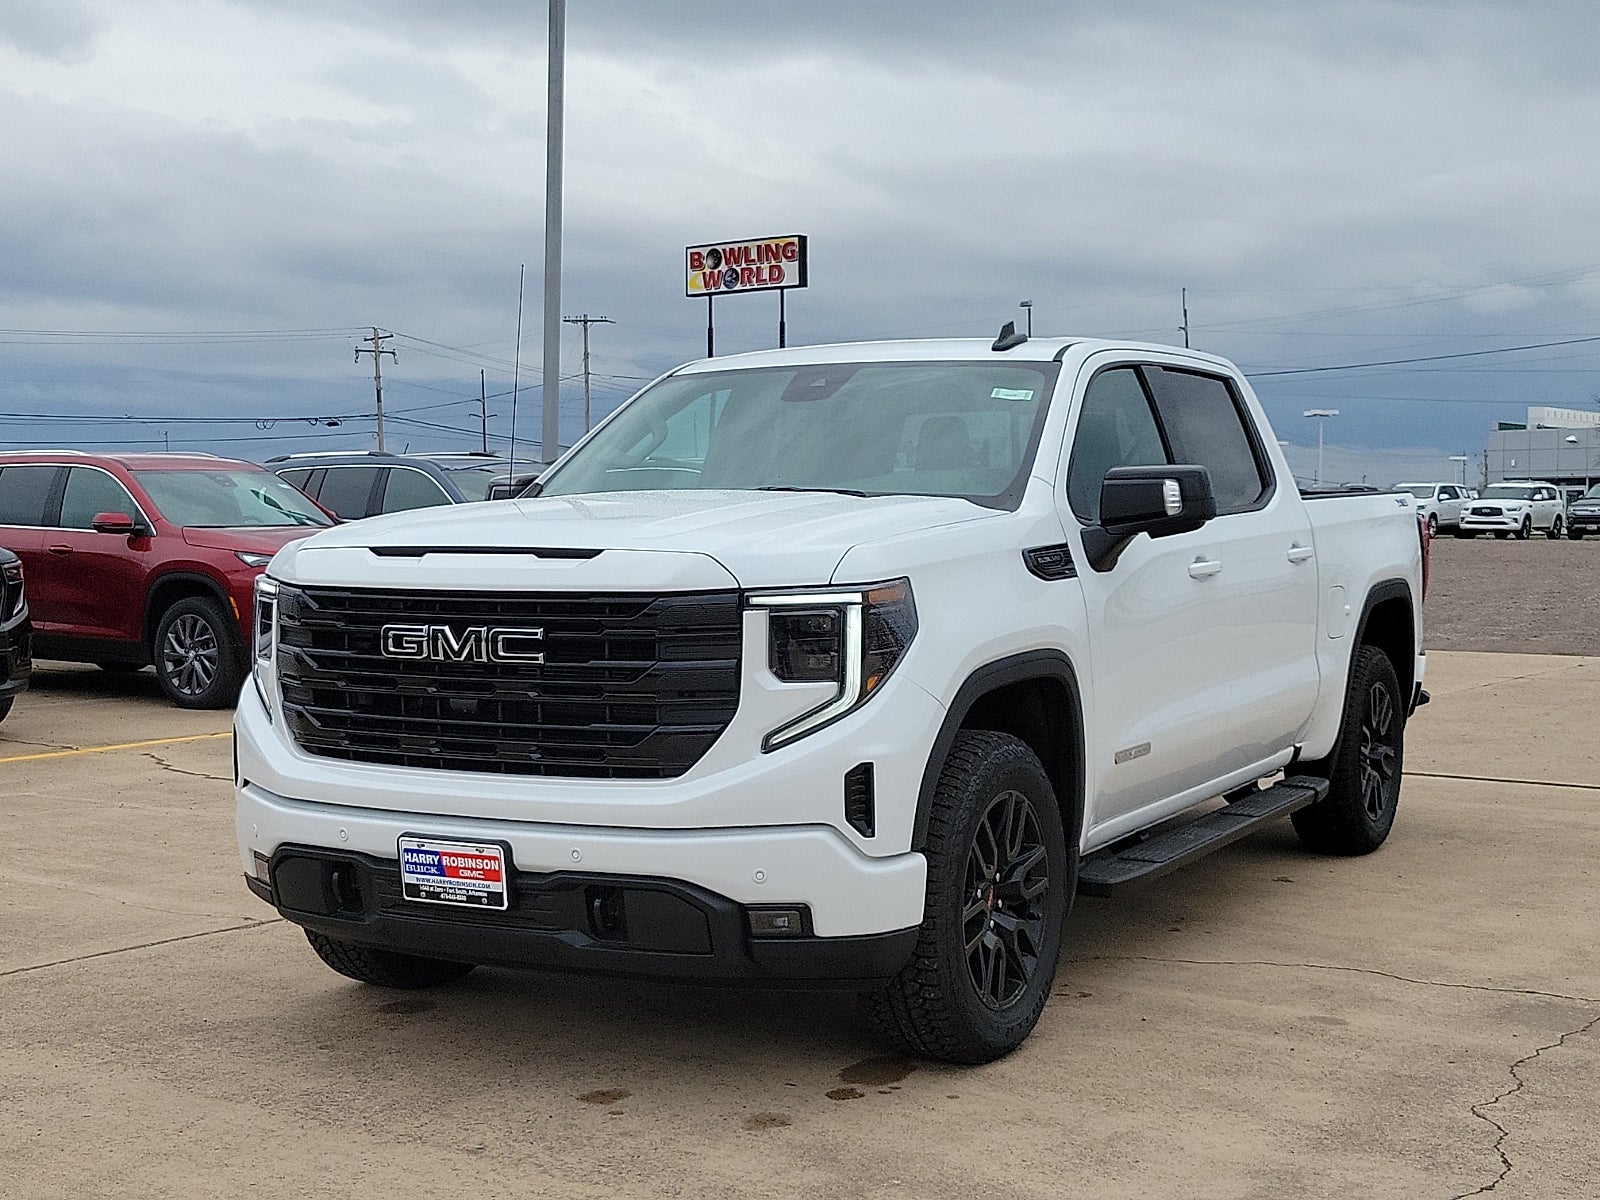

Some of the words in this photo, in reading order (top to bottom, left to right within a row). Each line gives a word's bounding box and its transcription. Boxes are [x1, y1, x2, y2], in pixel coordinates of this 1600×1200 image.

[690, 242, 797, 271] BOWLING
[702, 264, 785, 290] WORLD
[380, 624, 545, 665] GMC
[404, 852, 439, 865] HARRY
[442, 856, 499, 870] ROBINSON
[405, 864, 438, 874] BUICK
[459, 869, 485, 879] GMC
